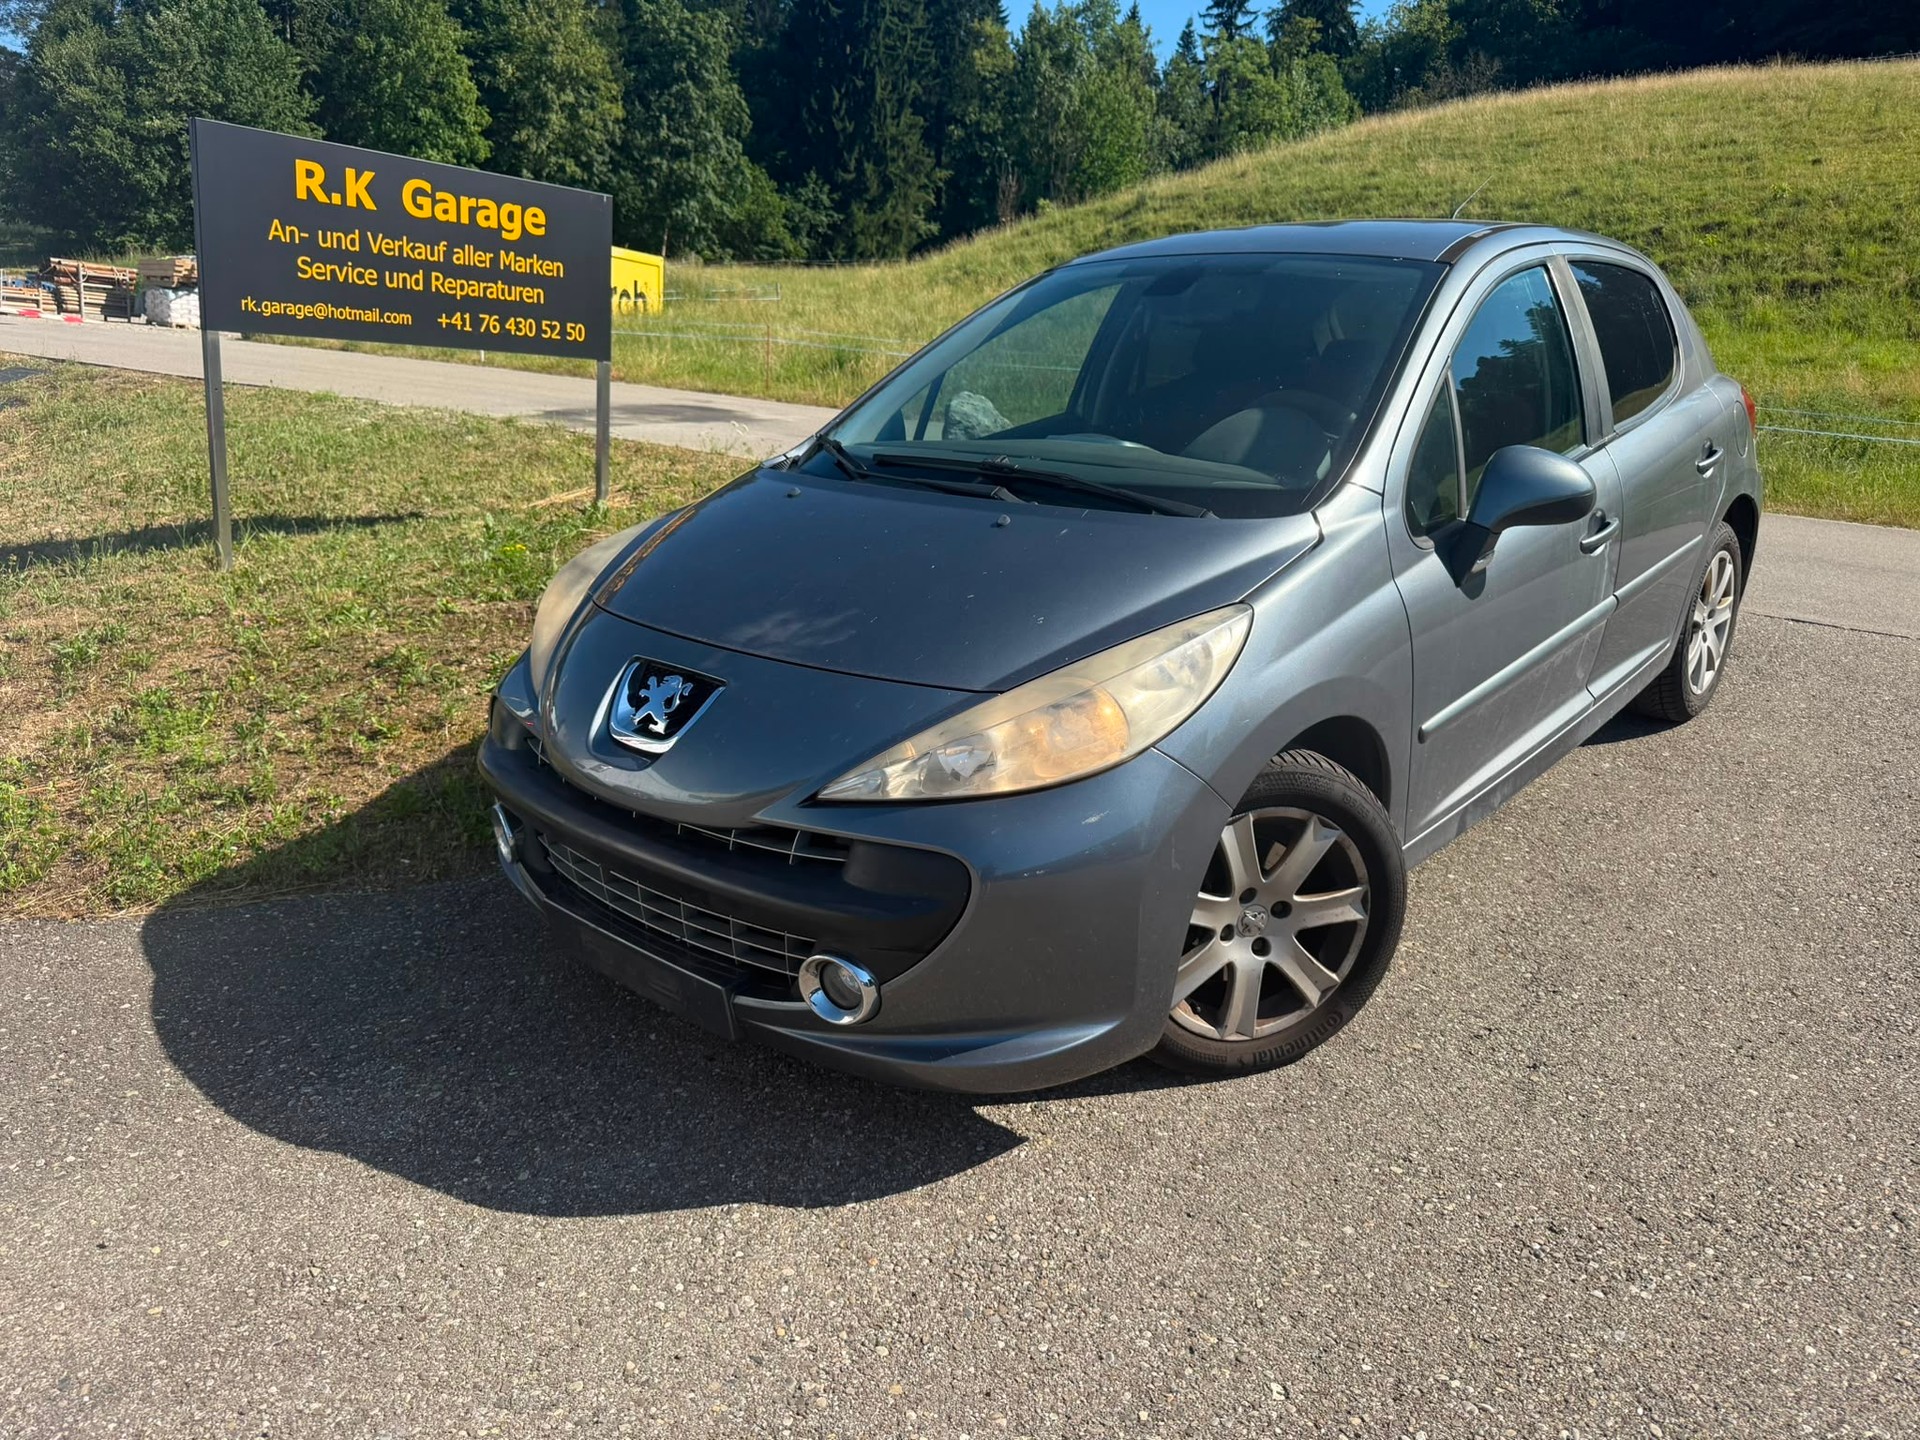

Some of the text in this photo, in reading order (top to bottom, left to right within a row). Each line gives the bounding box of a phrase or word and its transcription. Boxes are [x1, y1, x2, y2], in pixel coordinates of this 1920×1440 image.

[294, 158, 547, 242] R.K Garage
[268, 218, 566, 279] An- und Verkauf aller Marken
[296, 256, 546, 305] Service und Reparaturen
[240, 296, 414, 326] rk.garage@hotmail.com
[437, 312, 587, 343] +41 76 430 52 50
[1252, 1009, 1344, 1067] Continental
